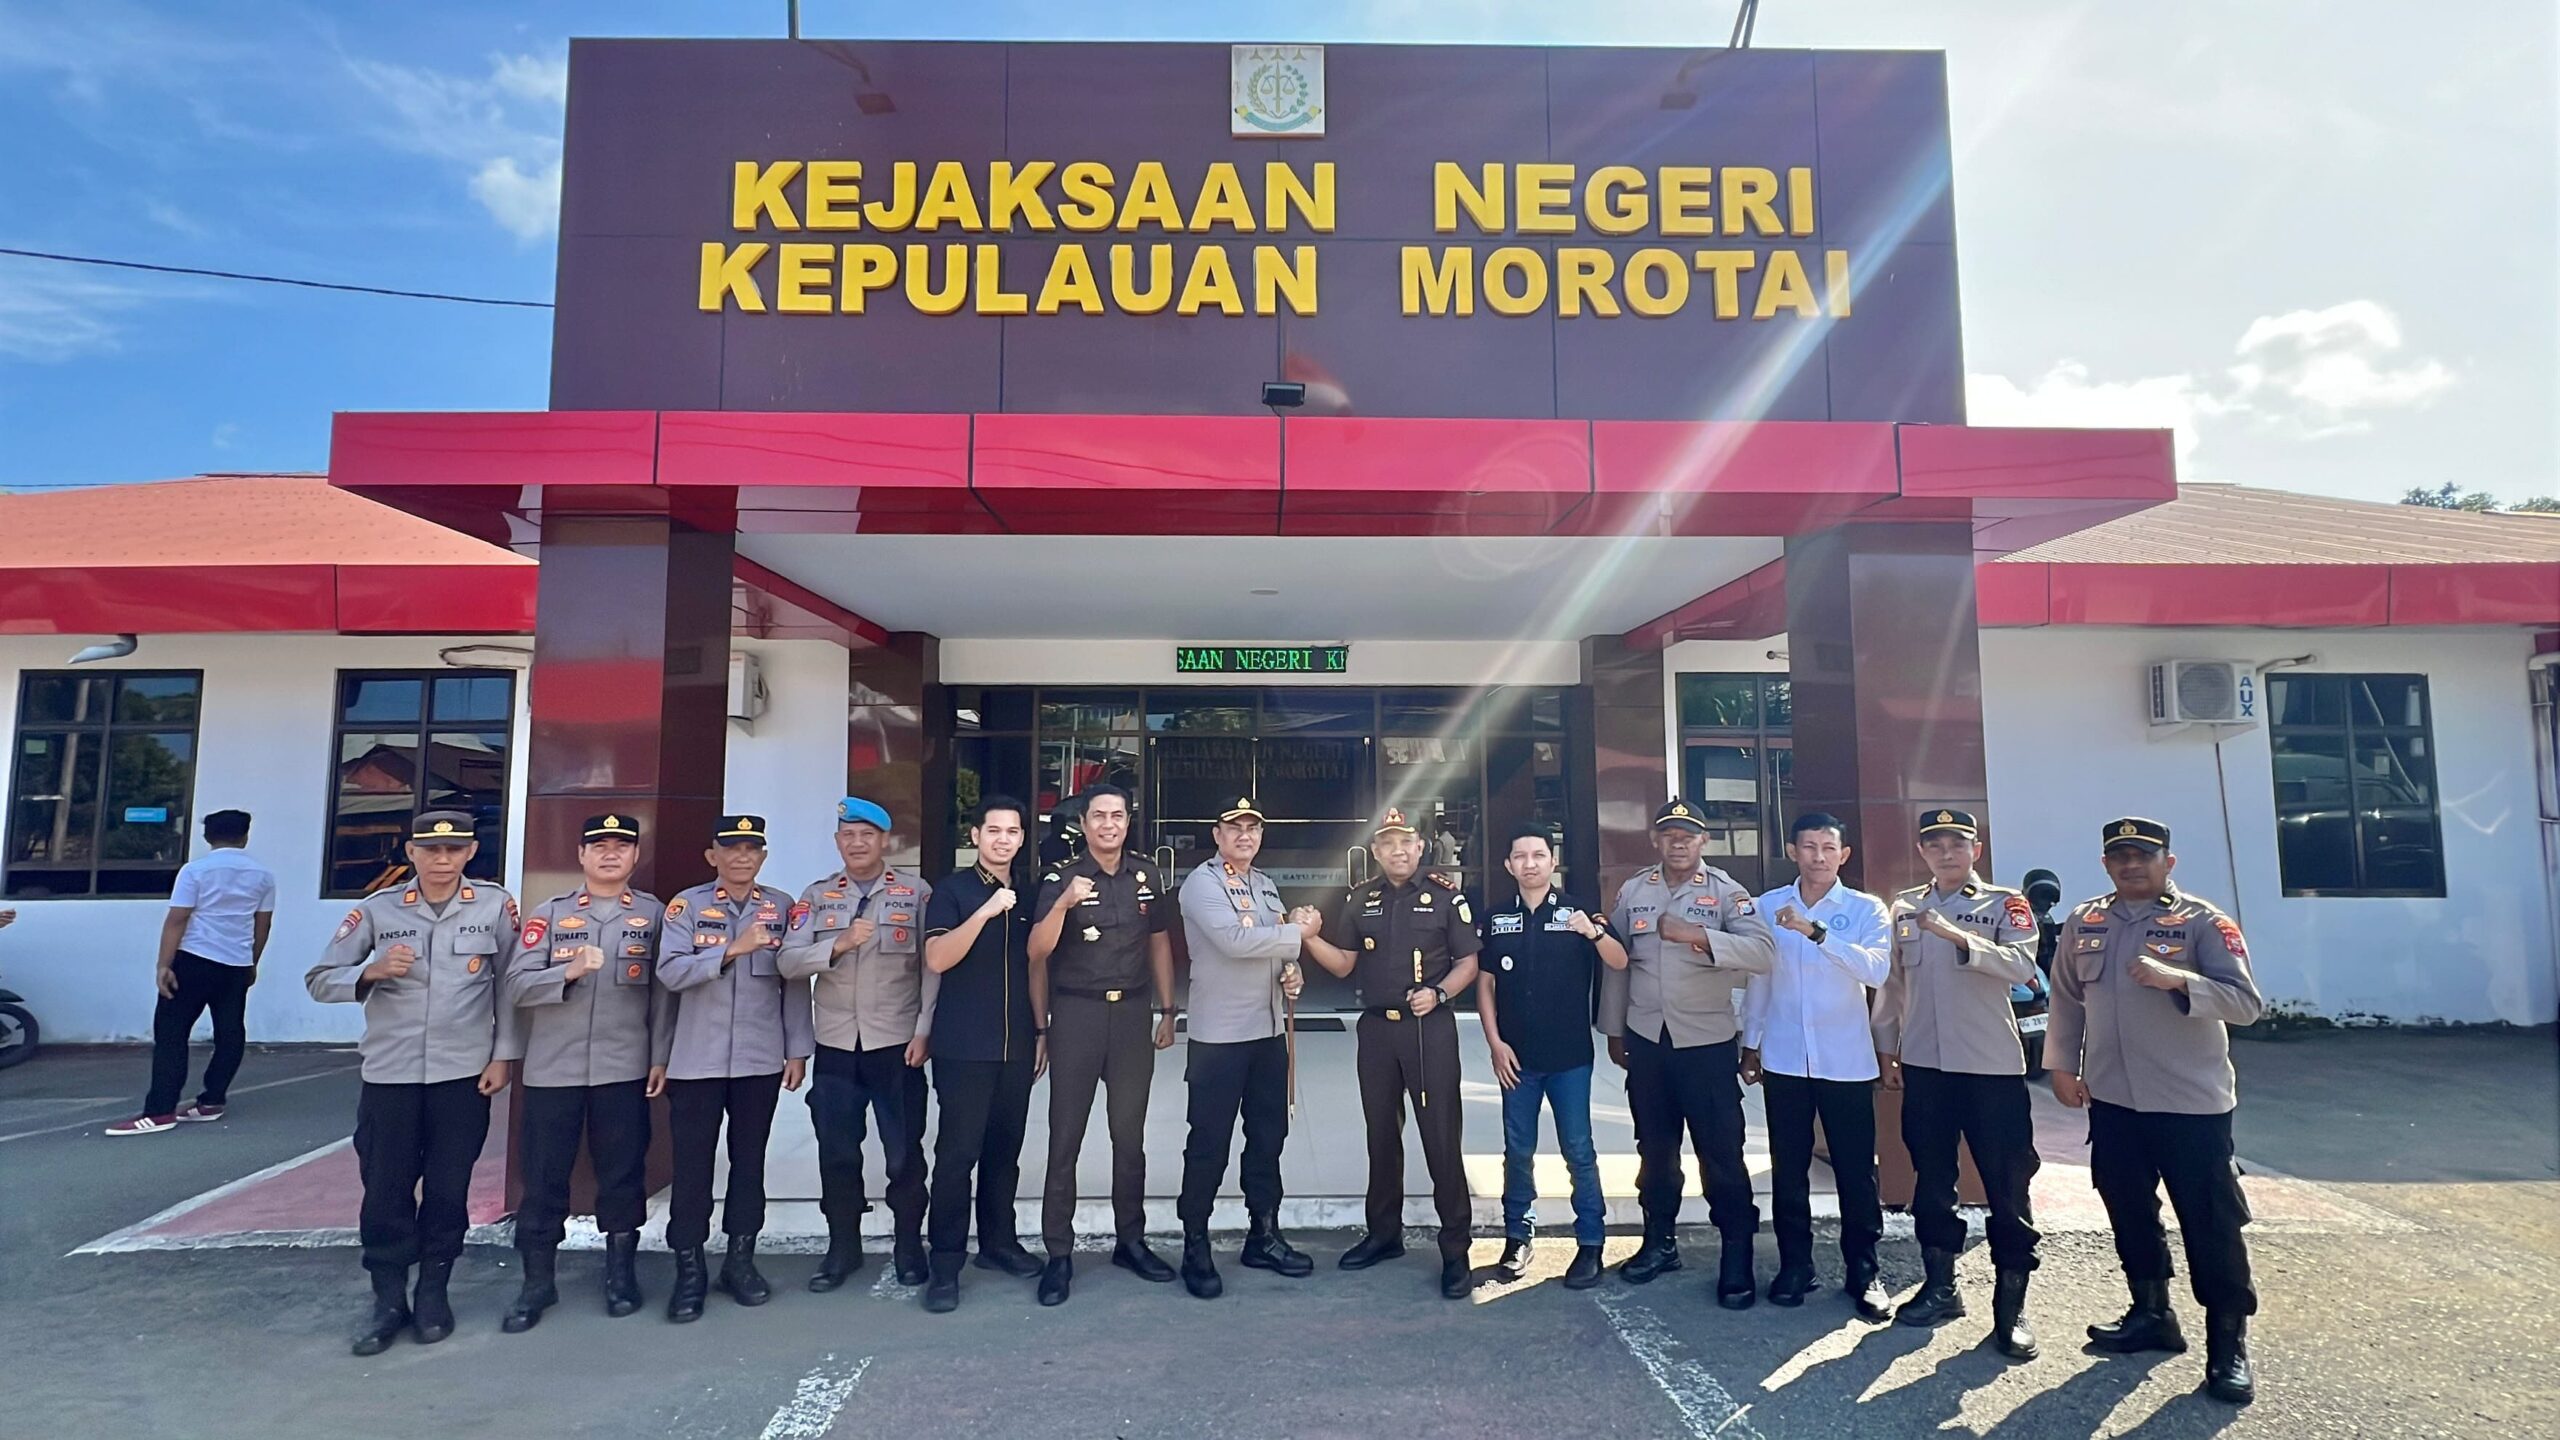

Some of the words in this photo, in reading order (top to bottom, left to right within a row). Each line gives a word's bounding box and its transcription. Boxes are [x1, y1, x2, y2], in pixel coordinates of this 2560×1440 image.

[733, 161, 1335, 232] KEJAKSAAN
[1433, 162, 1815, 236] NEGERI
[699, 242, 1317, 316] KEPULAUAN
[1402, 246, 1851, 320] MOROTAI
[1235, 650, 1312, 670] NEGERI
[2240, 676, 2254, 717] AUX
[1686, 907, 1718, 919] POLRI
[1957, 914, 1995, 926] POLRI
[379, 929, 417, 940] ANSAR
[459, 925, 494, 934] POLRI
[622, 931, 653, 939] POLRI
[2146, 929, 2186, 940] POLRI
